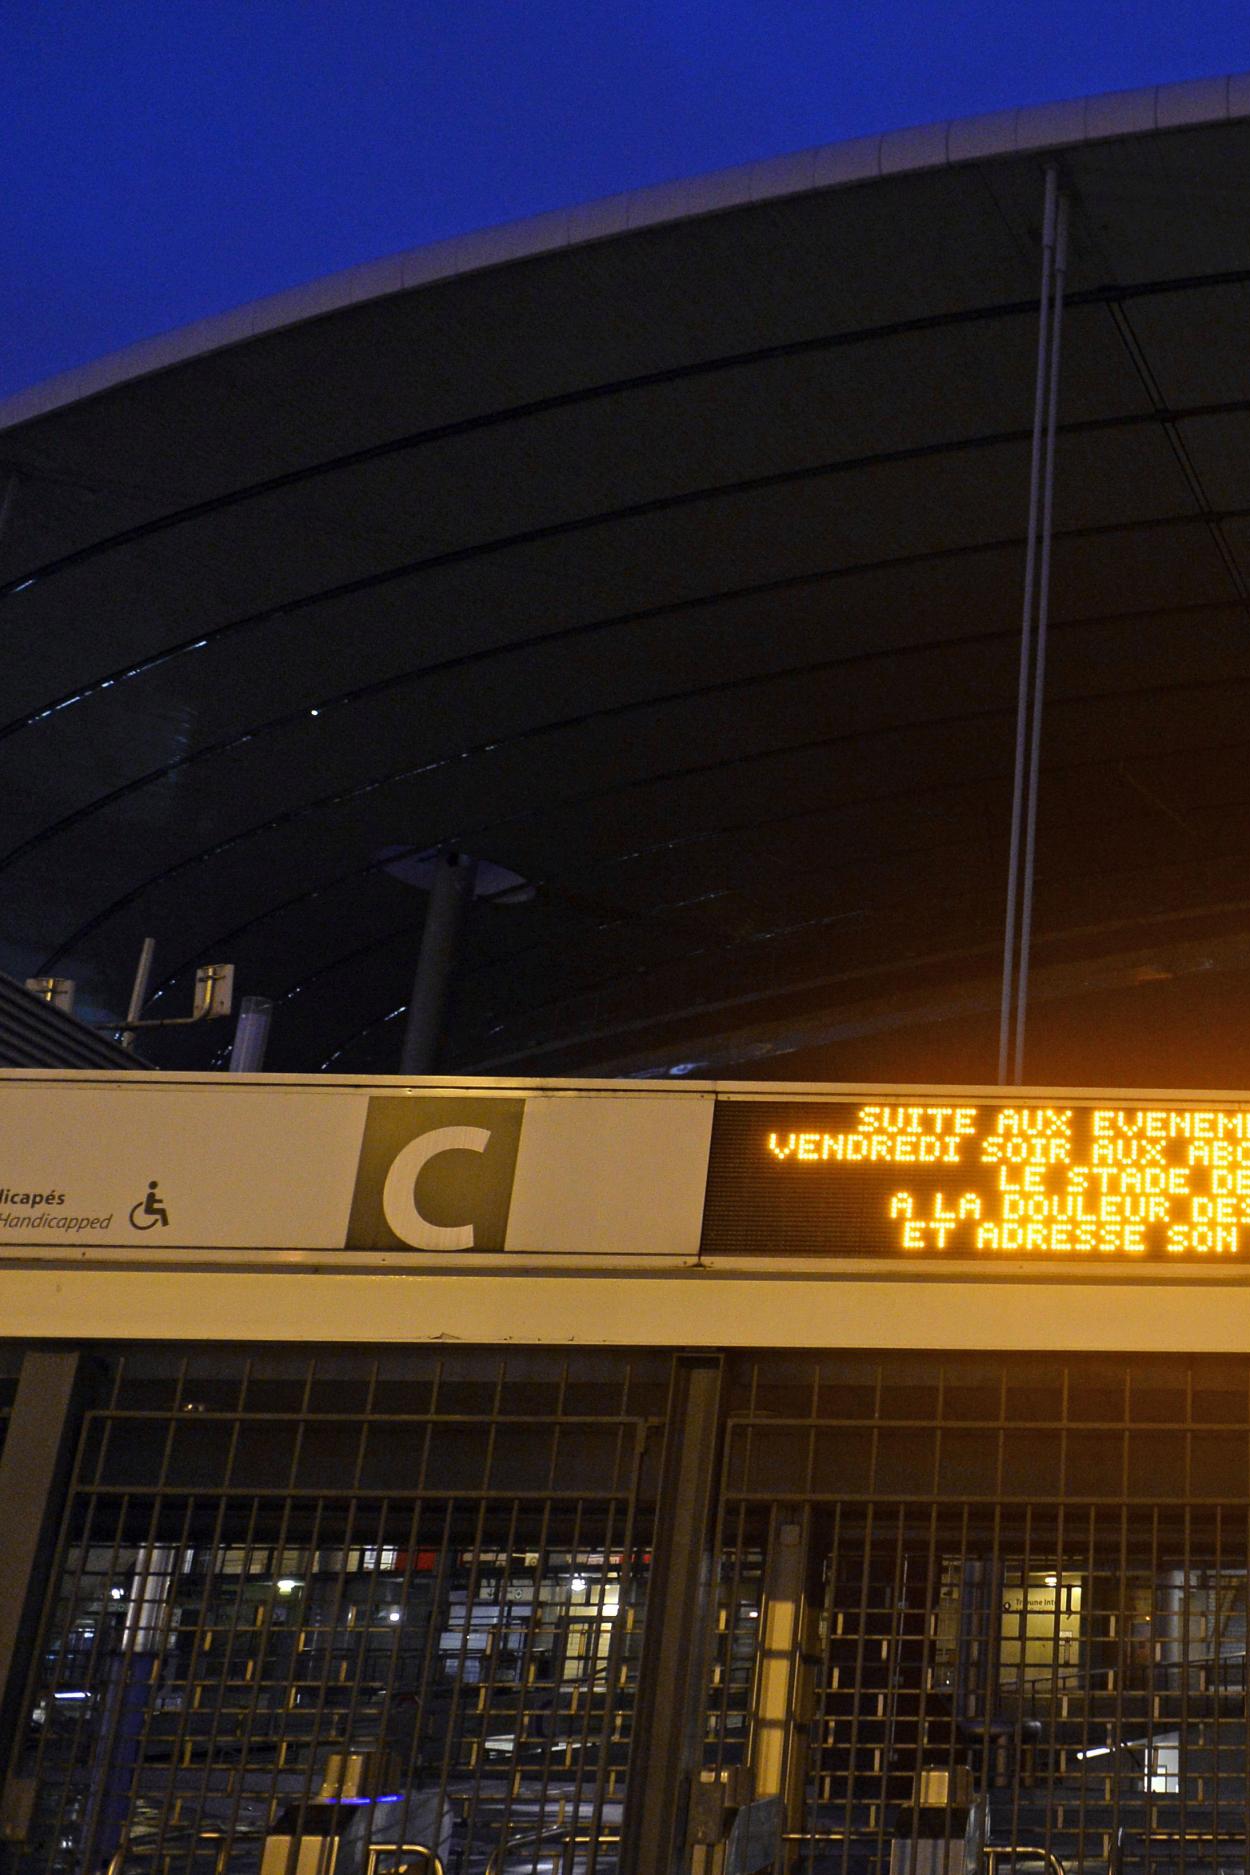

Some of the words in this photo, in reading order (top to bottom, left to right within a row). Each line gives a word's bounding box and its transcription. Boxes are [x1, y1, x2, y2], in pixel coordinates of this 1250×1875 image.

[857, 1106, 977, 1134] SUITE
[997, 1108, 1073, 1137] AUX
[769, 1133, 961, 1163] VENDREDI
[981, 1136, 1071, 1165] SOIR
[1091, 1138, 1167, 1166] AUX
[383, 1126, 491, 1250] C
[999, 1163, 1047, 1193] LE
[1066, 1166, 1191, 1195] STADE
[890, 1192, 913, 1219] A
[934, 1192, 982, 1220] LA
[1002, 1193, 1171, 1223] DOULEUR
[902, 1220, 956, 1249] ET
[976, 1220, 1146, 1252] ADRESSE
[1167, 1224, 1238, 1253] SON
